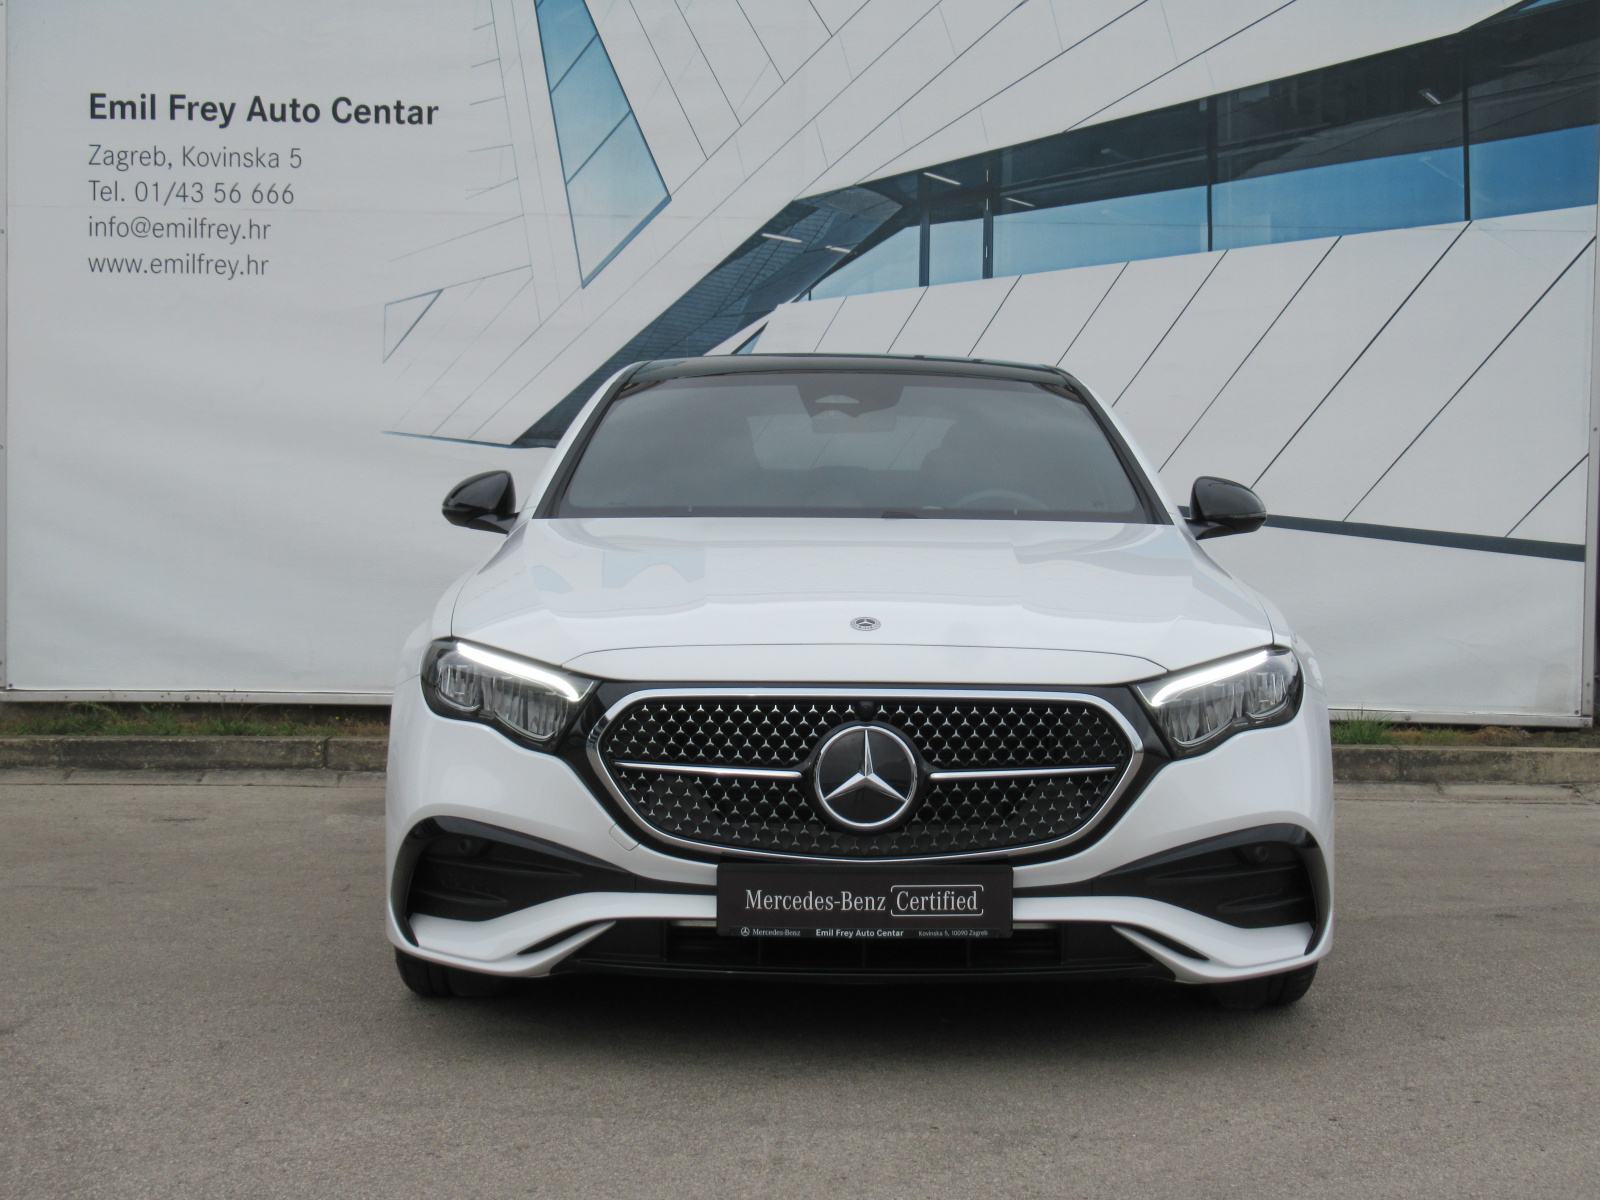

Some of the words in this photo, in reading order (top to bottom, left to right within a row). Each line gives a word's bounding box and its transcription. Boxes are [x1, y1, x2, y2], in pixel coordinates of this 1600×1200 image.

[89, 92, 156, 120] Emil
[168, 94, 237, 129] Frey
[246, 95, 321, 123] Auto
[331, 96, 440, 126] Centar
[88, 144, 173, 172] Zagreb,
[182, 145, 280, 169] Kovinska
[289, 148, 303, 169] 5
[88, 180, 125, 202] Tel.
[135, 181, 204, 206] 01/43
[213, 182, 242, 204] 56
[251, 183, 295, 205] 666
[88, 216, 272, 245] info@emilfrey.hr
[88, 253, 270, 281] www.emilfrey.hr
[745, 889, 886, 912] Mercedes-Benz
[896, 890, 978, 911] Certified
[815, 928, 834, 937] Emil
[835, 928, 854, 939] Frey
[855, 928, 875, 937] Auto
[876, 928, 905, 937] Centar
